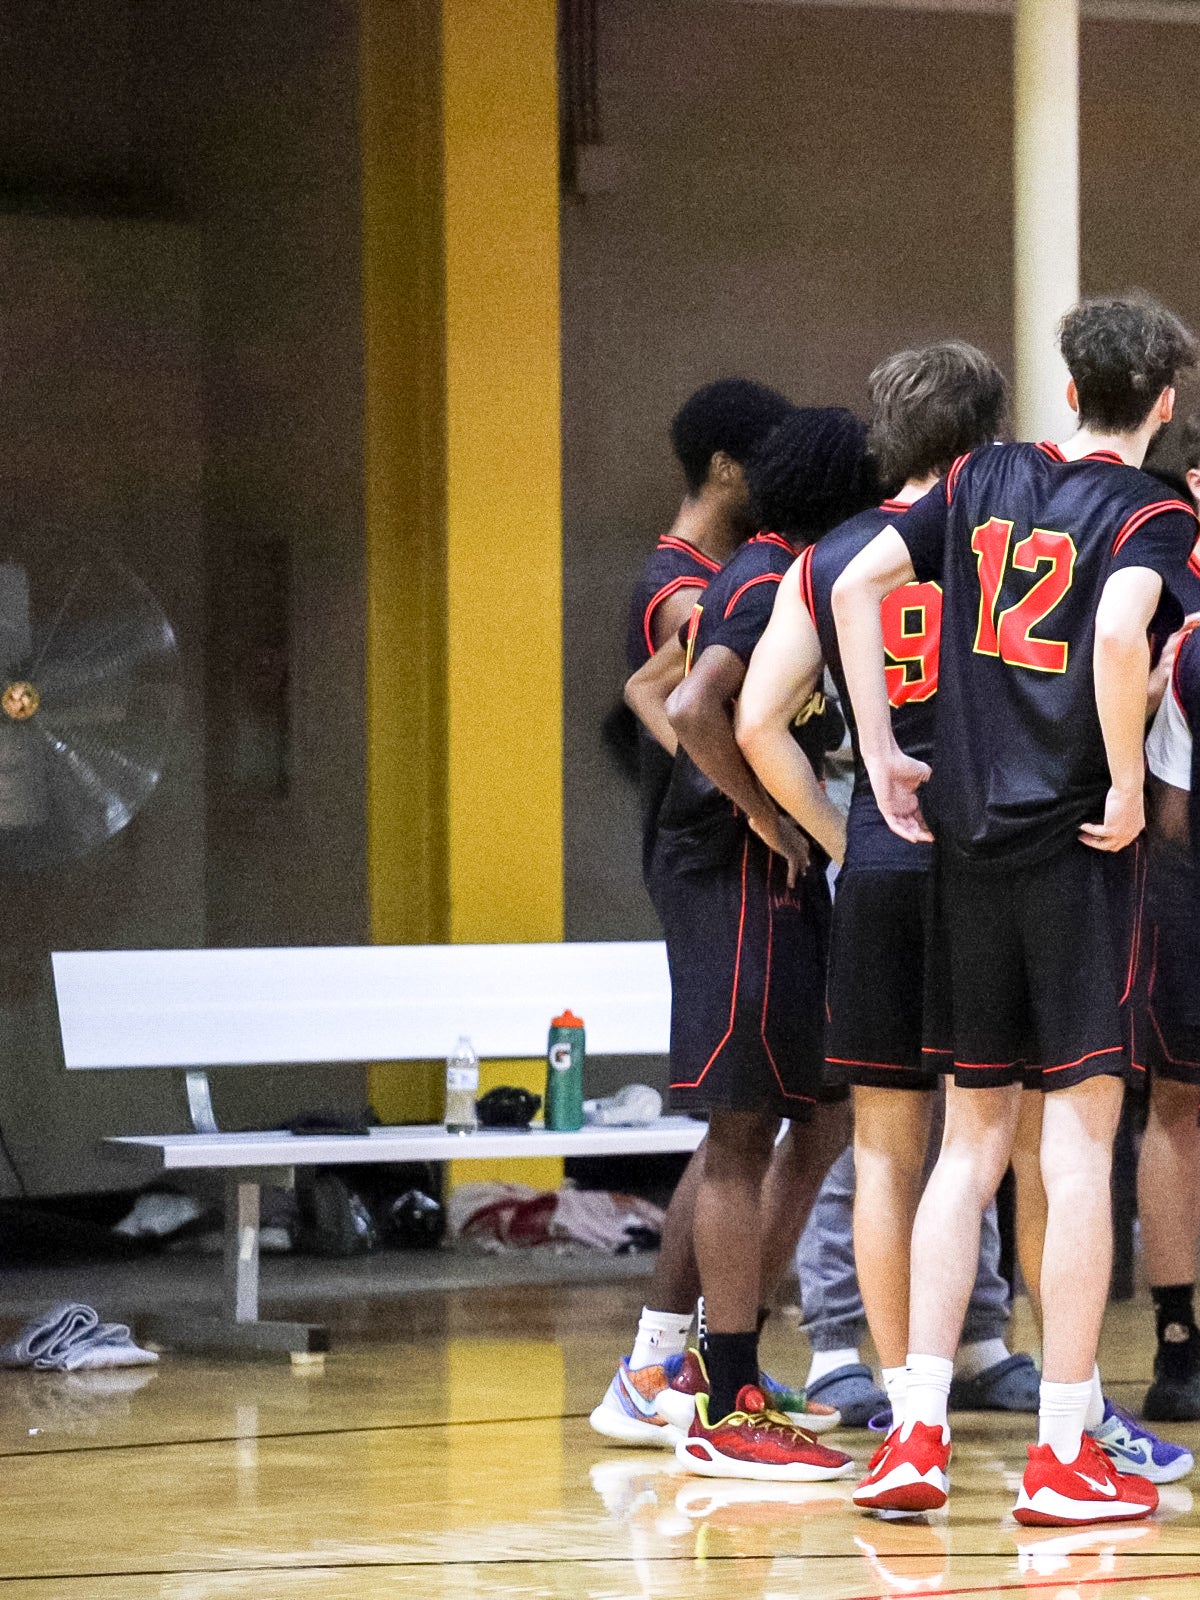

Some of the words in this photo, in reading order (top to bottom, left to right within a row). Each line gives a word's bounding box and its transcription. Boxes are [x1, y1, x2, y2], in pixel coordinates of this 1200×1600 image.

[881, 582, 943, 707] 9
[972, 516, 1077, 673] 12
[550, 1042, 572, 1071] G
